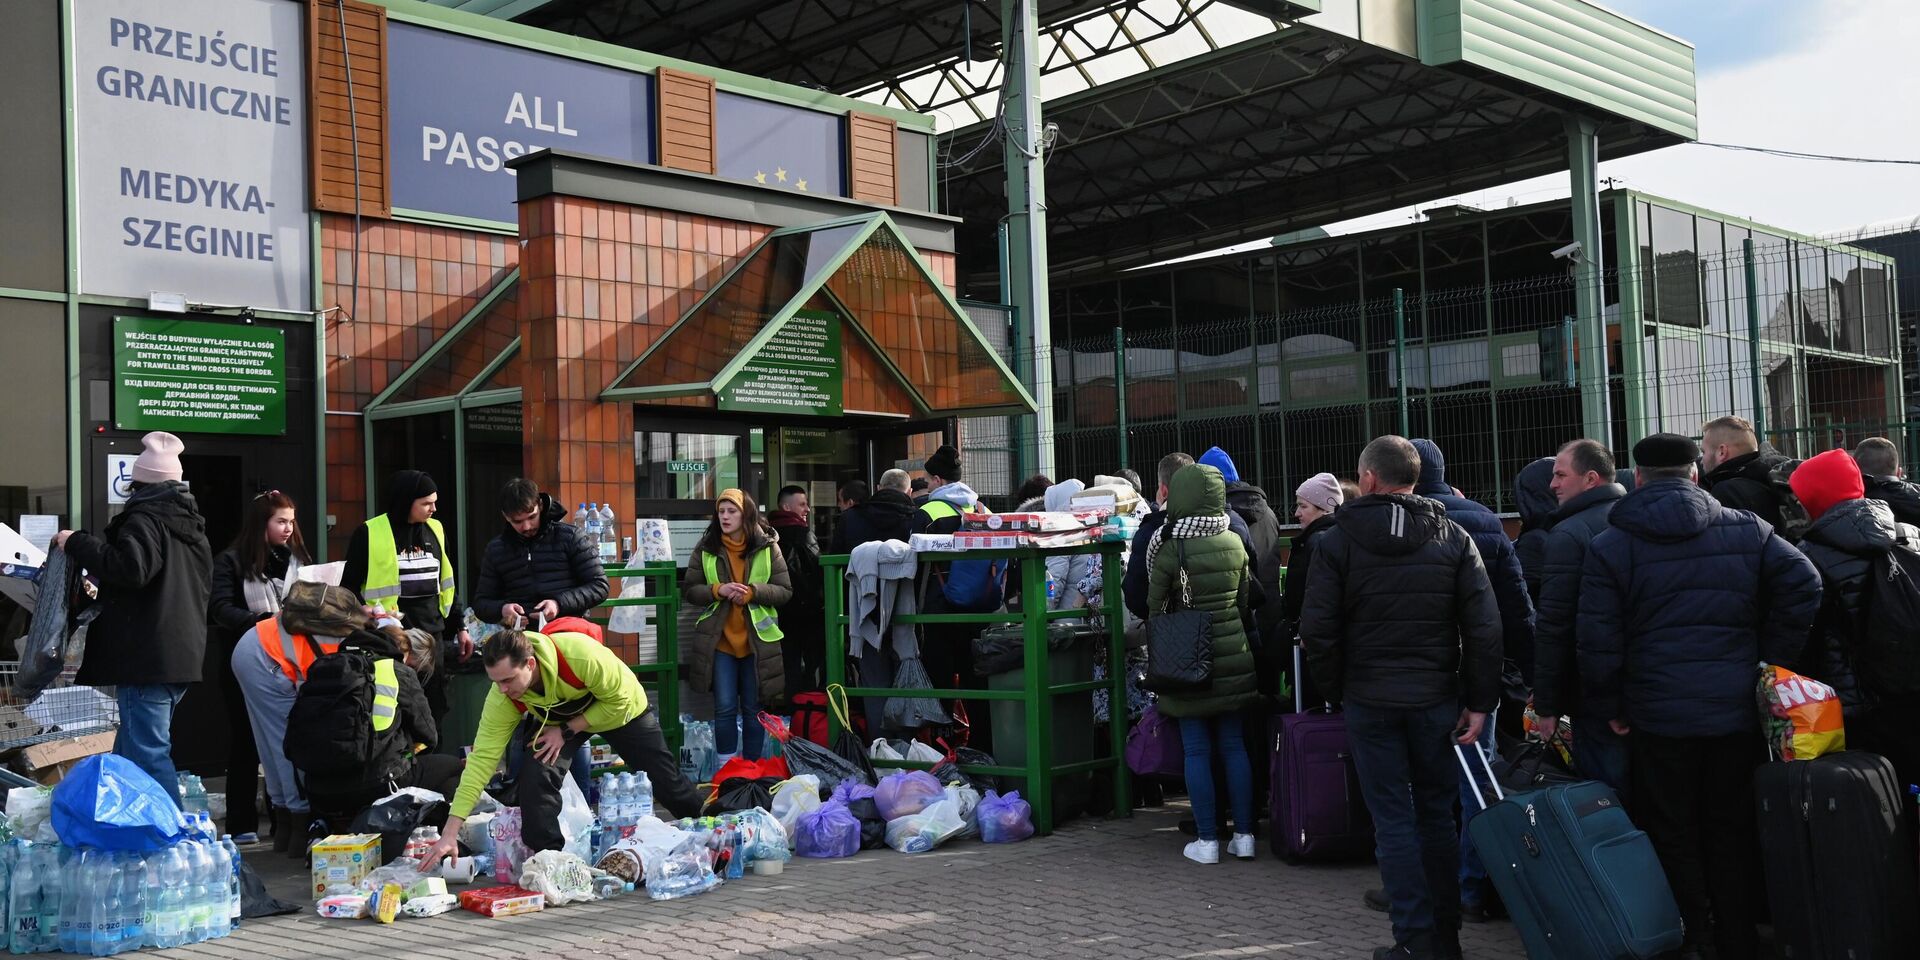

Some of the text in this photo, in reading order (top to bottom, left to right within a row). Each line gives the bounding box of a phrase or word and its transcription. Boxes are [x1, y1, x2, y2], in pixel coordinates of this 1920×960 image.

[110, 17, 278, 78] PRZEJŚCIE
[96, 66, 291, 126] GRANICZNE
[504, 92, 578, 136] ALL
[422, 126, 546, 176] PASS
[120, 166, 276, 214] MEDYKA-
[122, 216, 274, 262] SZEGINIE
[125, 332, 156, 340] WEJŚCIE
[169, 335, 202, 344] BUDYNKU
[203, 338, 242, 346] WYŁĄCZNIE
[257, 341, 274, 349] OSÓB
[126, 342, 198, 352] PRZEKRACZAJĄCYCH
[200, 347, 229, 356] GRANICĘ
[221, 357, 264, 366] EXCLUSIVELY
[124, 379, 142, 388] ВХІД
[228, 385, 277, 394] ПЕРЕТИНАЮТЬ
[165, 391, 210, 400] ДЕРЖАВНИЙ
[672, 462, 704, 470] WEJŚCIE
